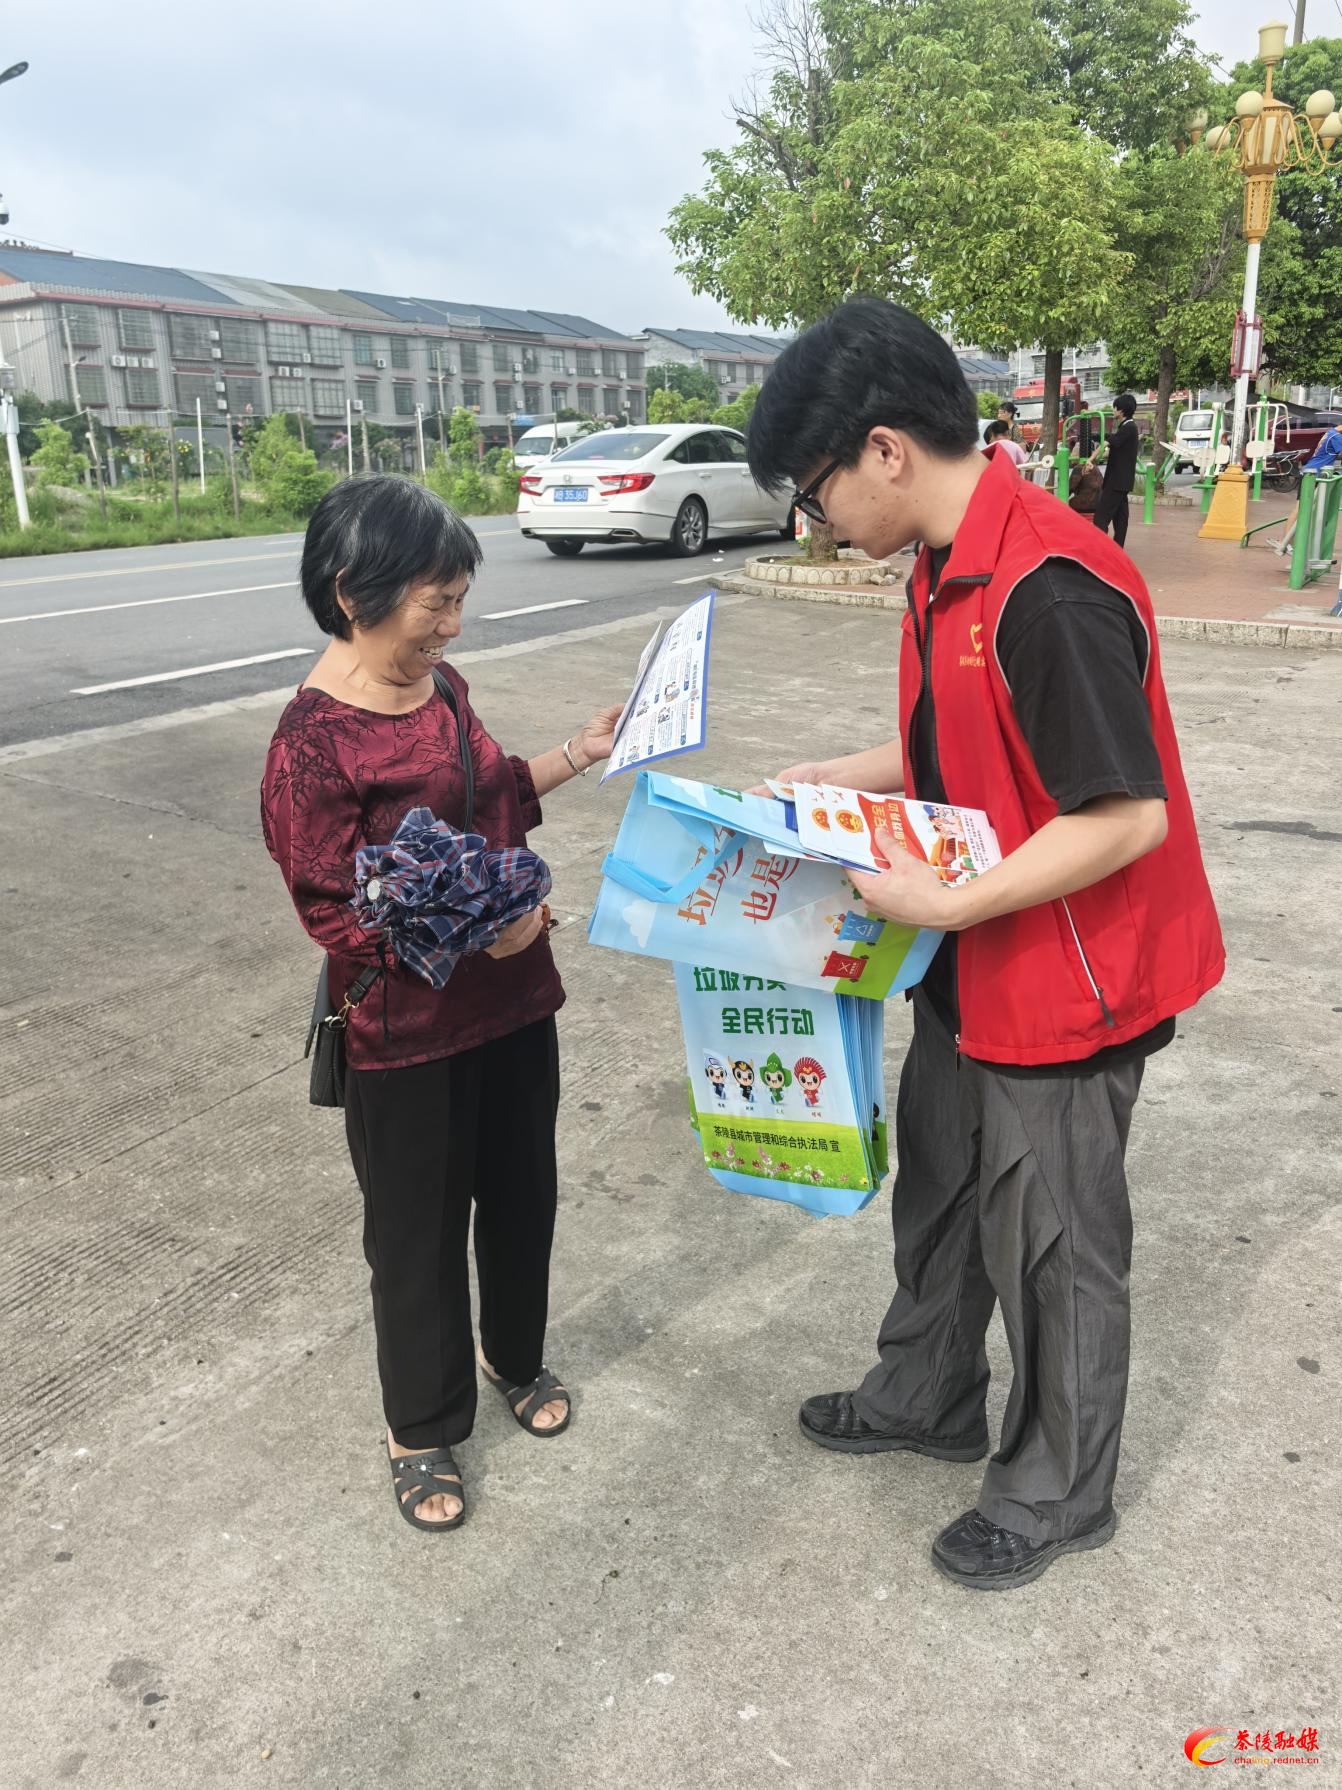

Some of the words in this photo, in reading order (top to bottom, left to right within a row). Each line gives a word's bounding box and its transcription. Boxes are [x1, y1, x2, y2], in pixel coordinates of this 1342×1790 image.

[721, 1007, 815, 1036] 全民行动
[713, 1125, 829, 1151] 茶陵县城市管理和综合执法局
